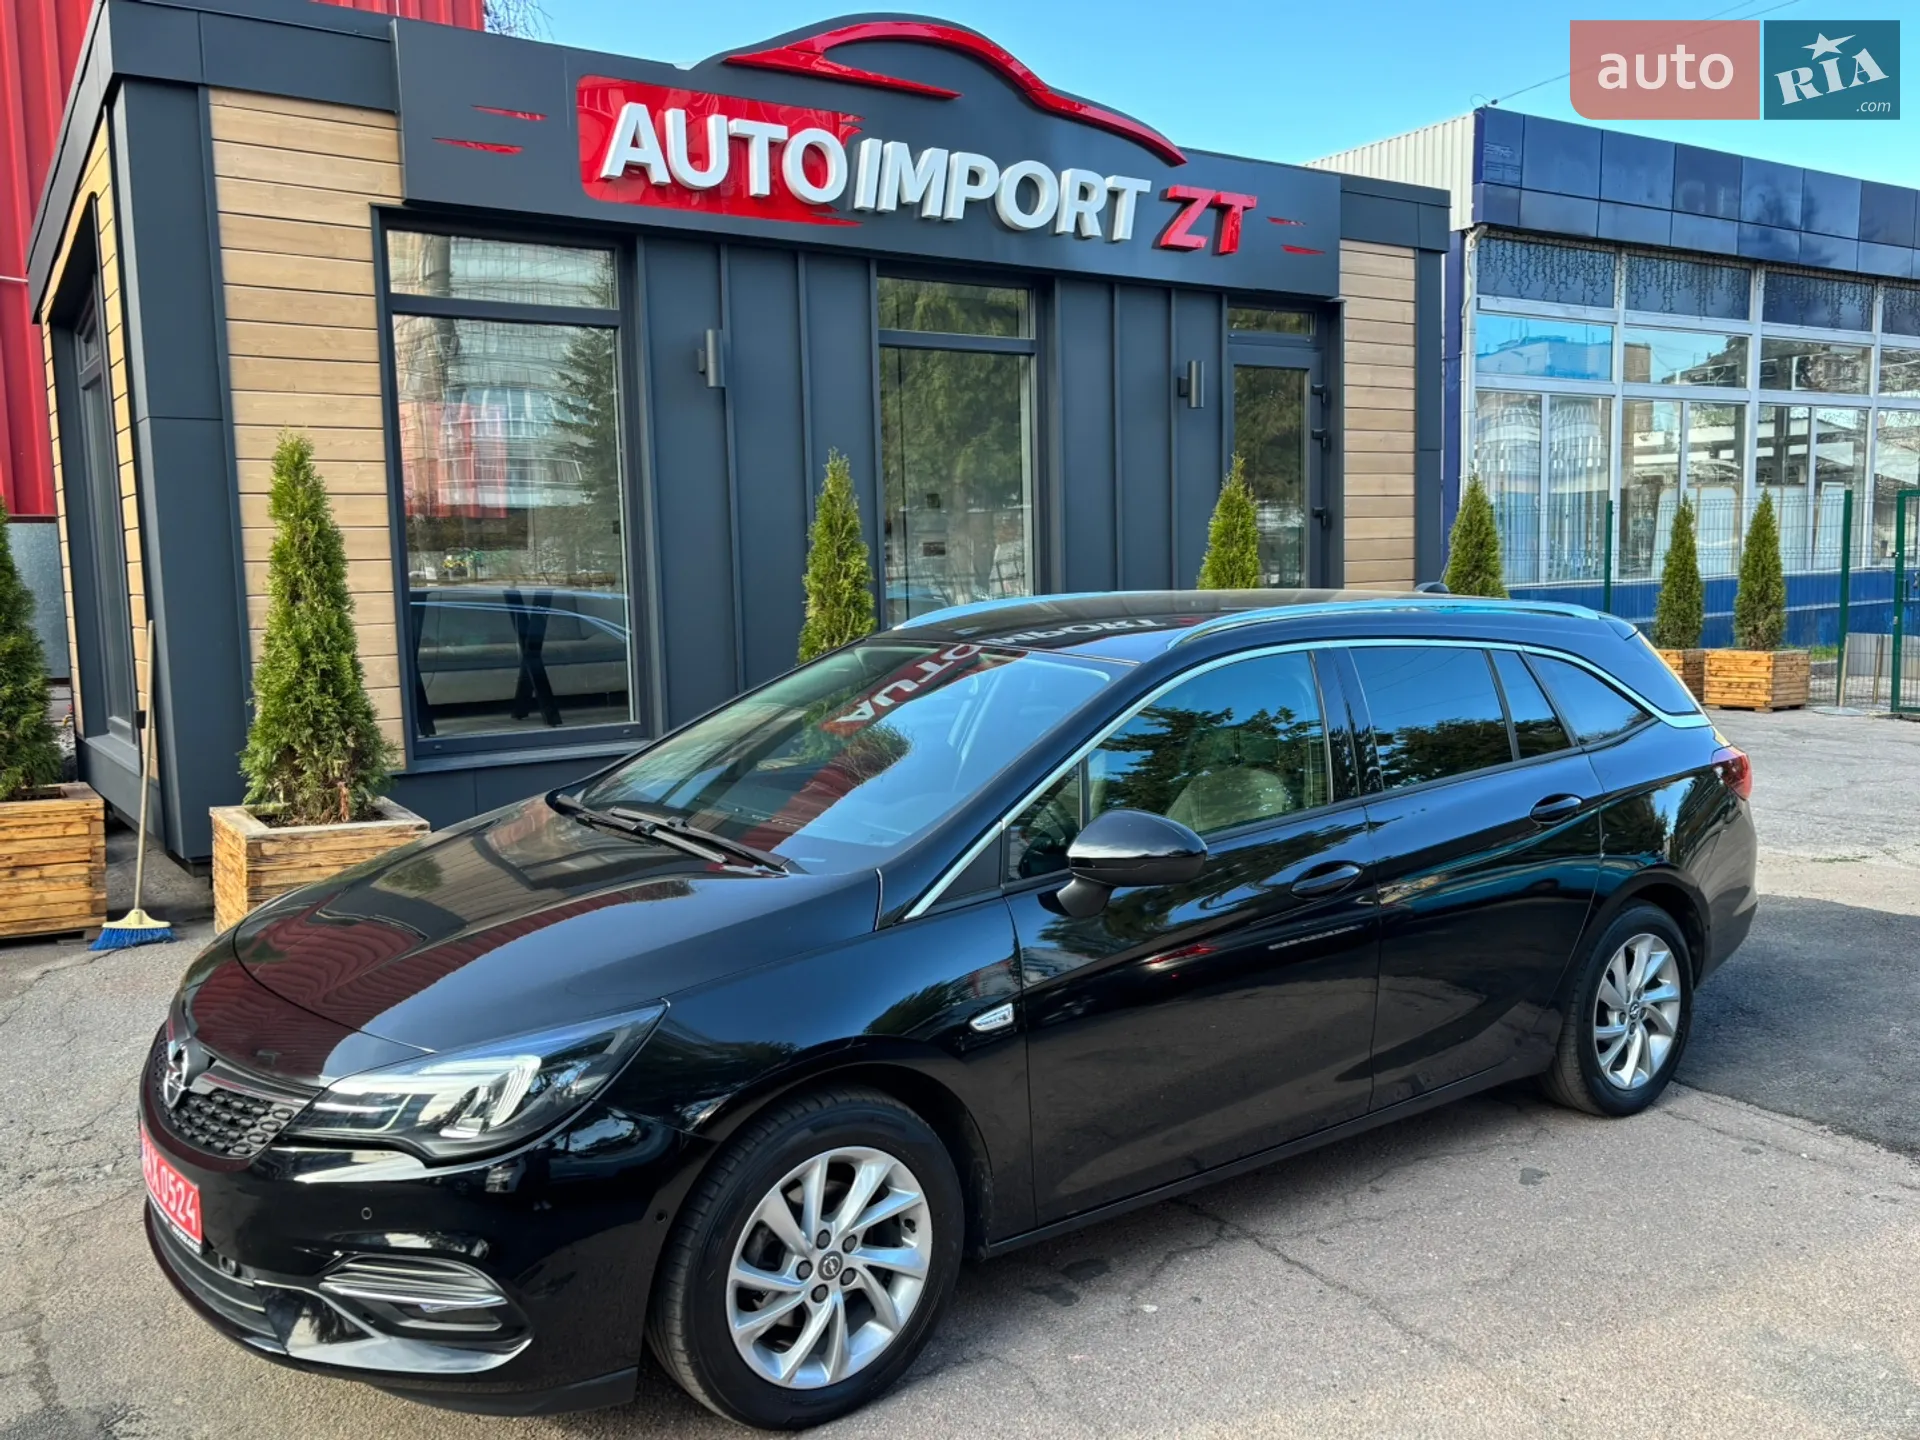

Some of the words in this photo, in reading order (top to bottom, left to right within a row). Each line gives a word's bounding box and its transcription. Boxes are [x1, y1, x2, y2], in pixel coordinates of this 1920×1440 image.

[600, 101, 848, 205] AUTO
[854, 138, 1151, 243] IMPORT
[1160, 185, 1257, 256] ZT
